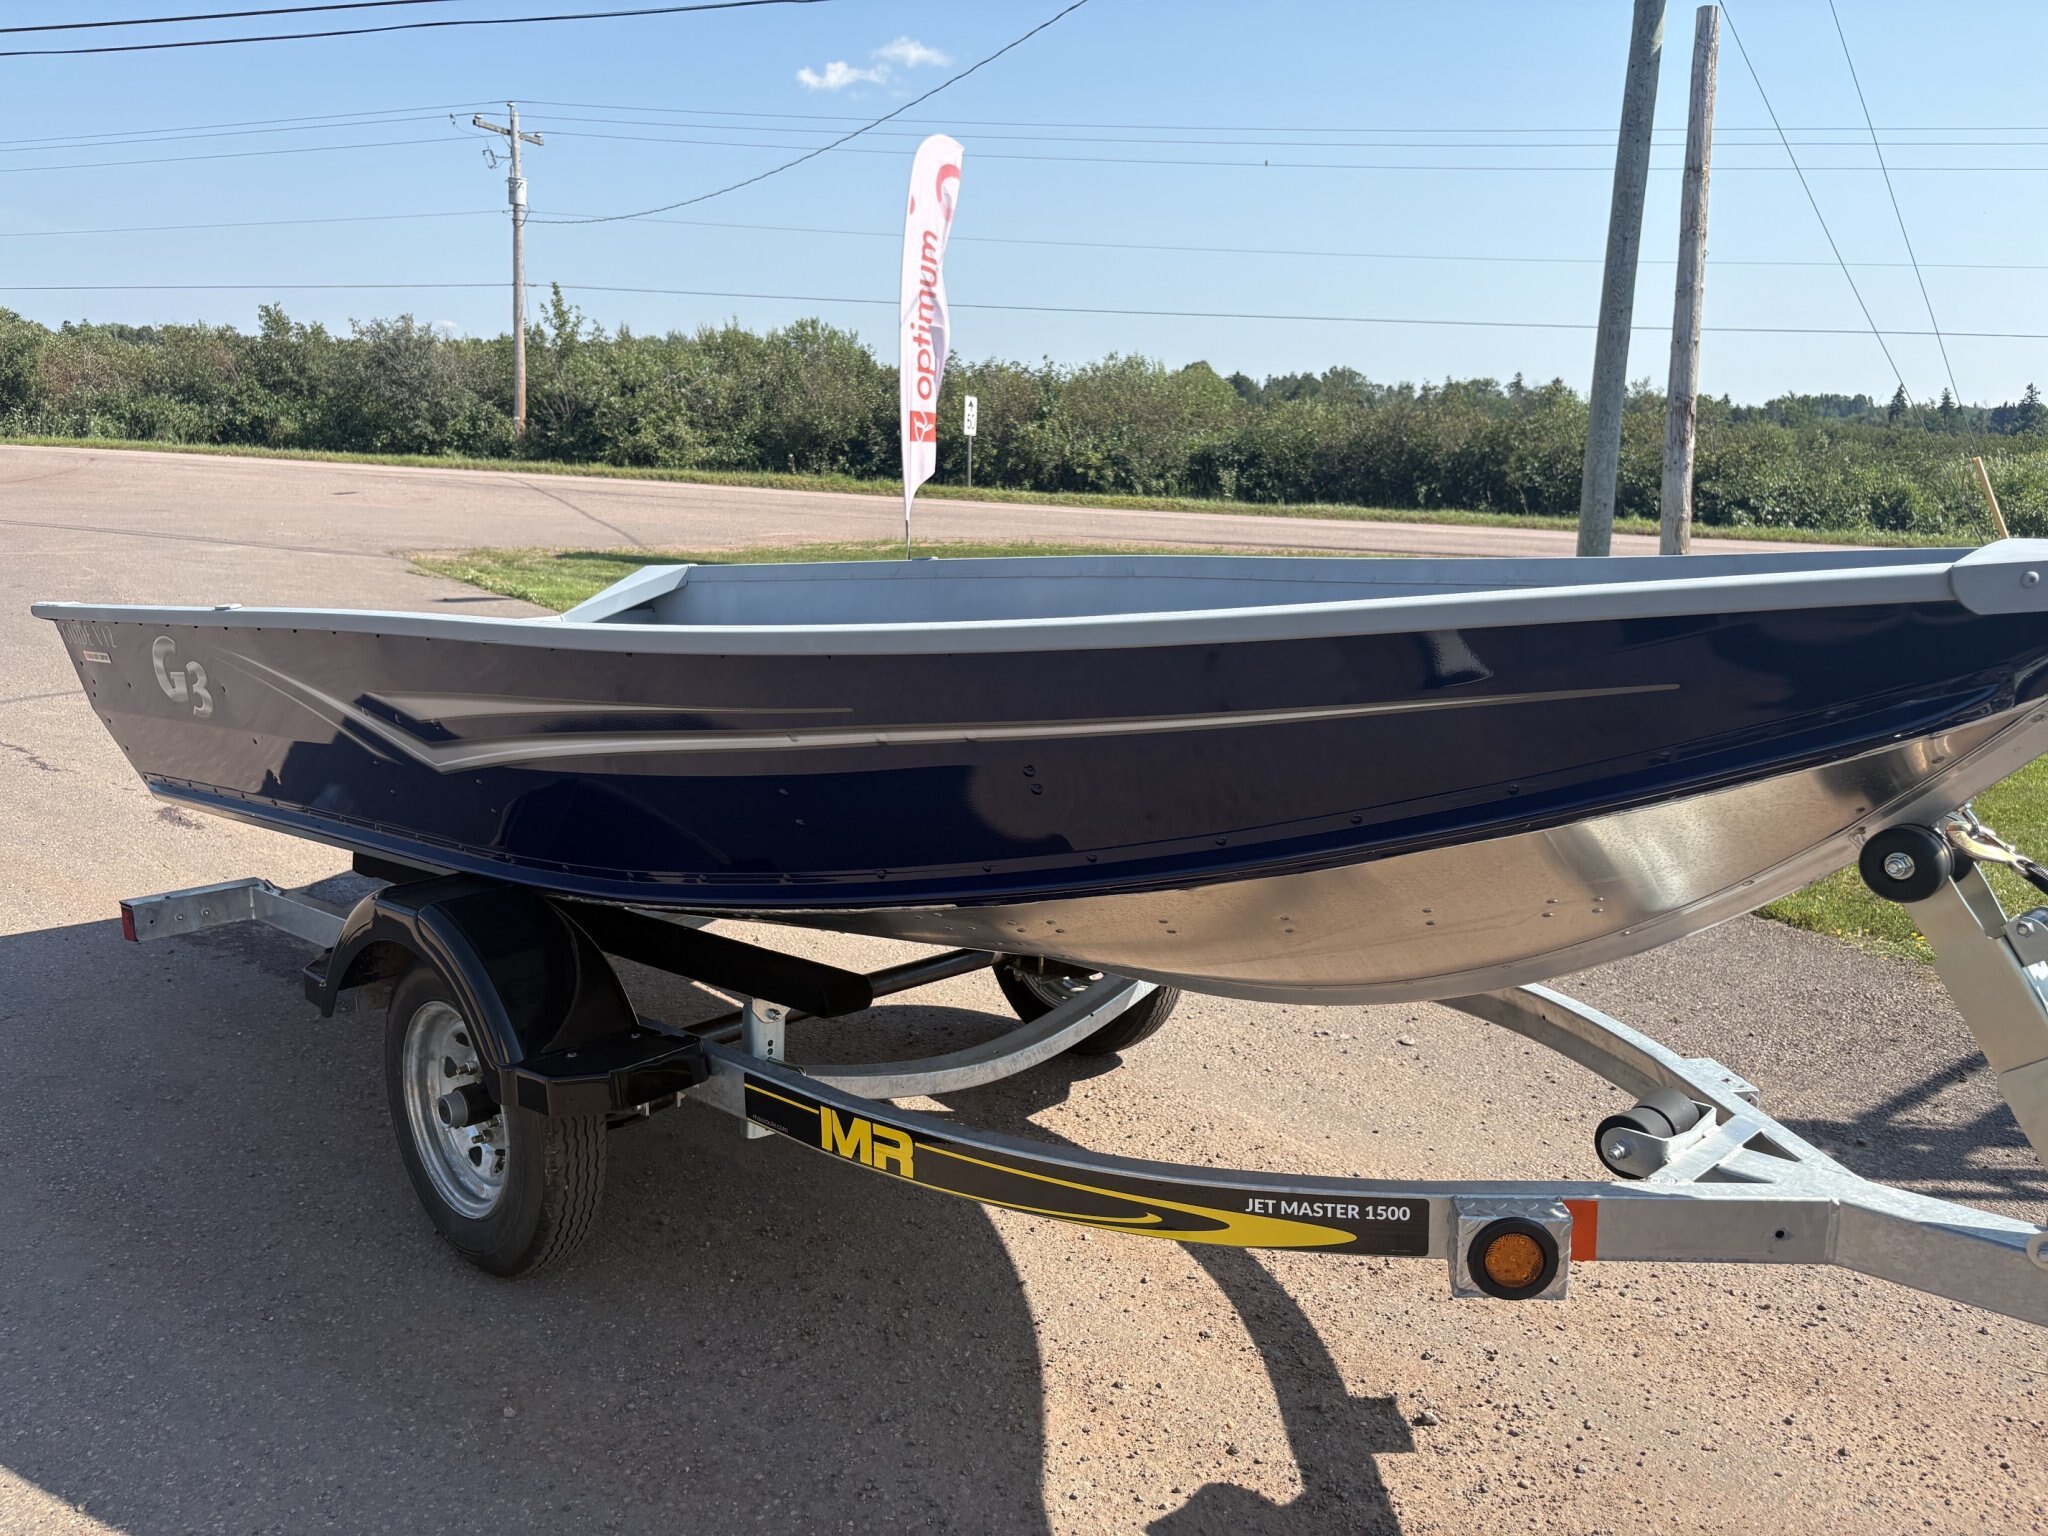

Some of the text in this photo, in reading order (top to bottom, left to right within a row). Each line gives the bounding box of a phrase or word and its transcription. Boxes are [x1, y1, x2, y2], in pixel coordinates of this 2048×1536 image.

[911, 230, 938, 400] optimum
[61, 622, 95, 647] GUIDE
[152, 635, 214, 719] G3
[820, 1105, 915, 1180] MR
[1245, 1198, 1411, 1221] JET MASTER 1500
